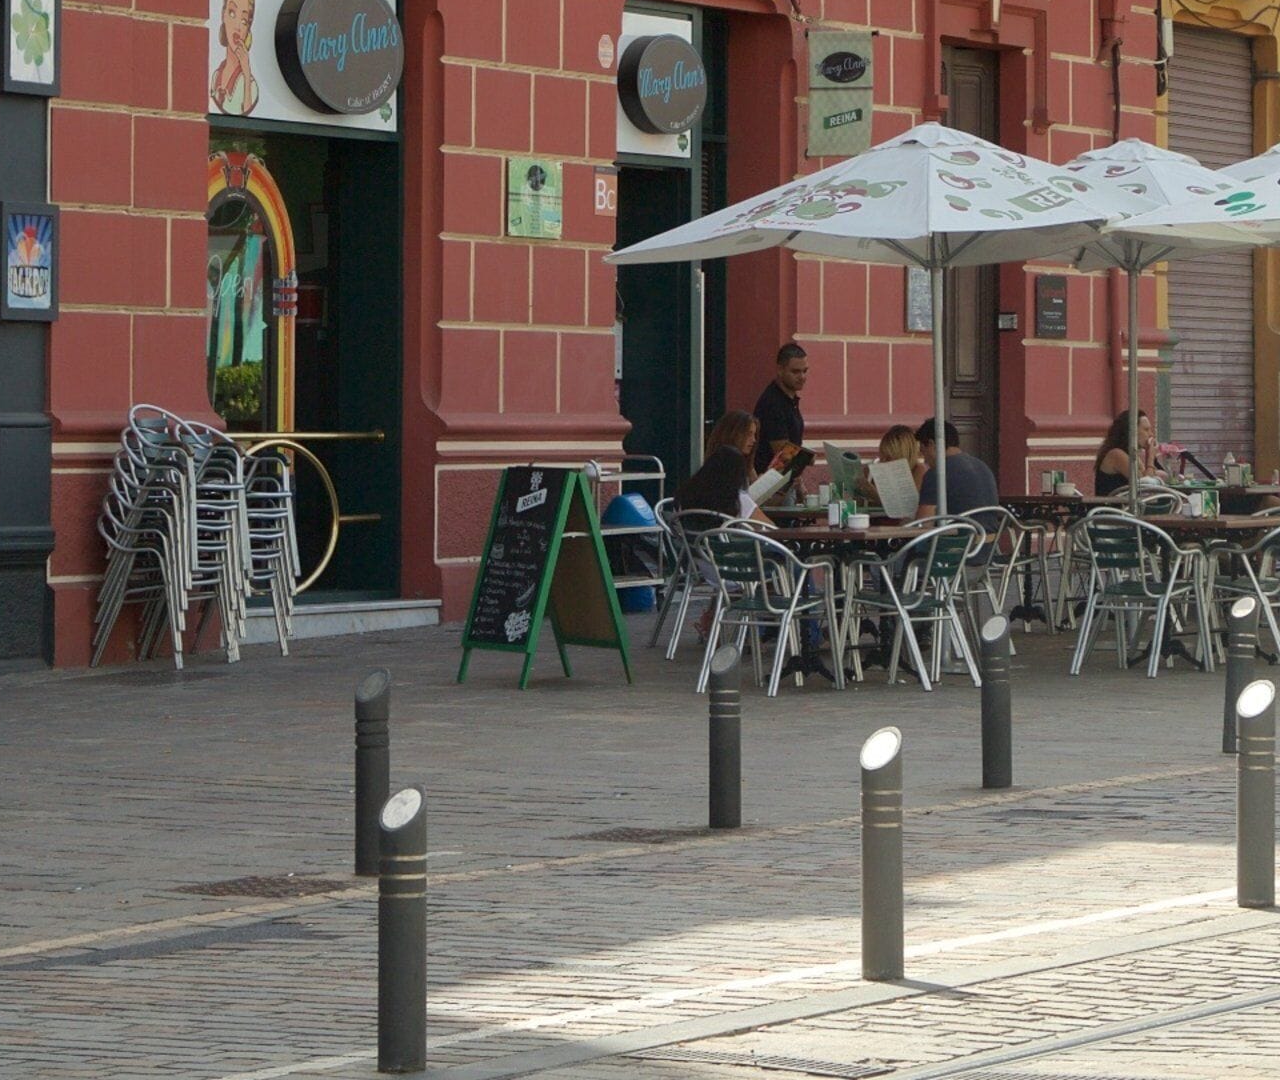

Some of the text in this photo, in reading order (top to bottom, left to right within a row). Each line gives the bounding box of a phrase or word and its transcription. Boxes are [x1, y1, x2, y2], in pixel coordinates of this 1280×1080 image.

[297, 12, 400, 72] Mary Ann's
[639, 66, 672, 104] Mary
[829, 111, 857, 127] REINA
[595, 178, 616, 210] Bc
[521, 491, 544, 508] REINA
